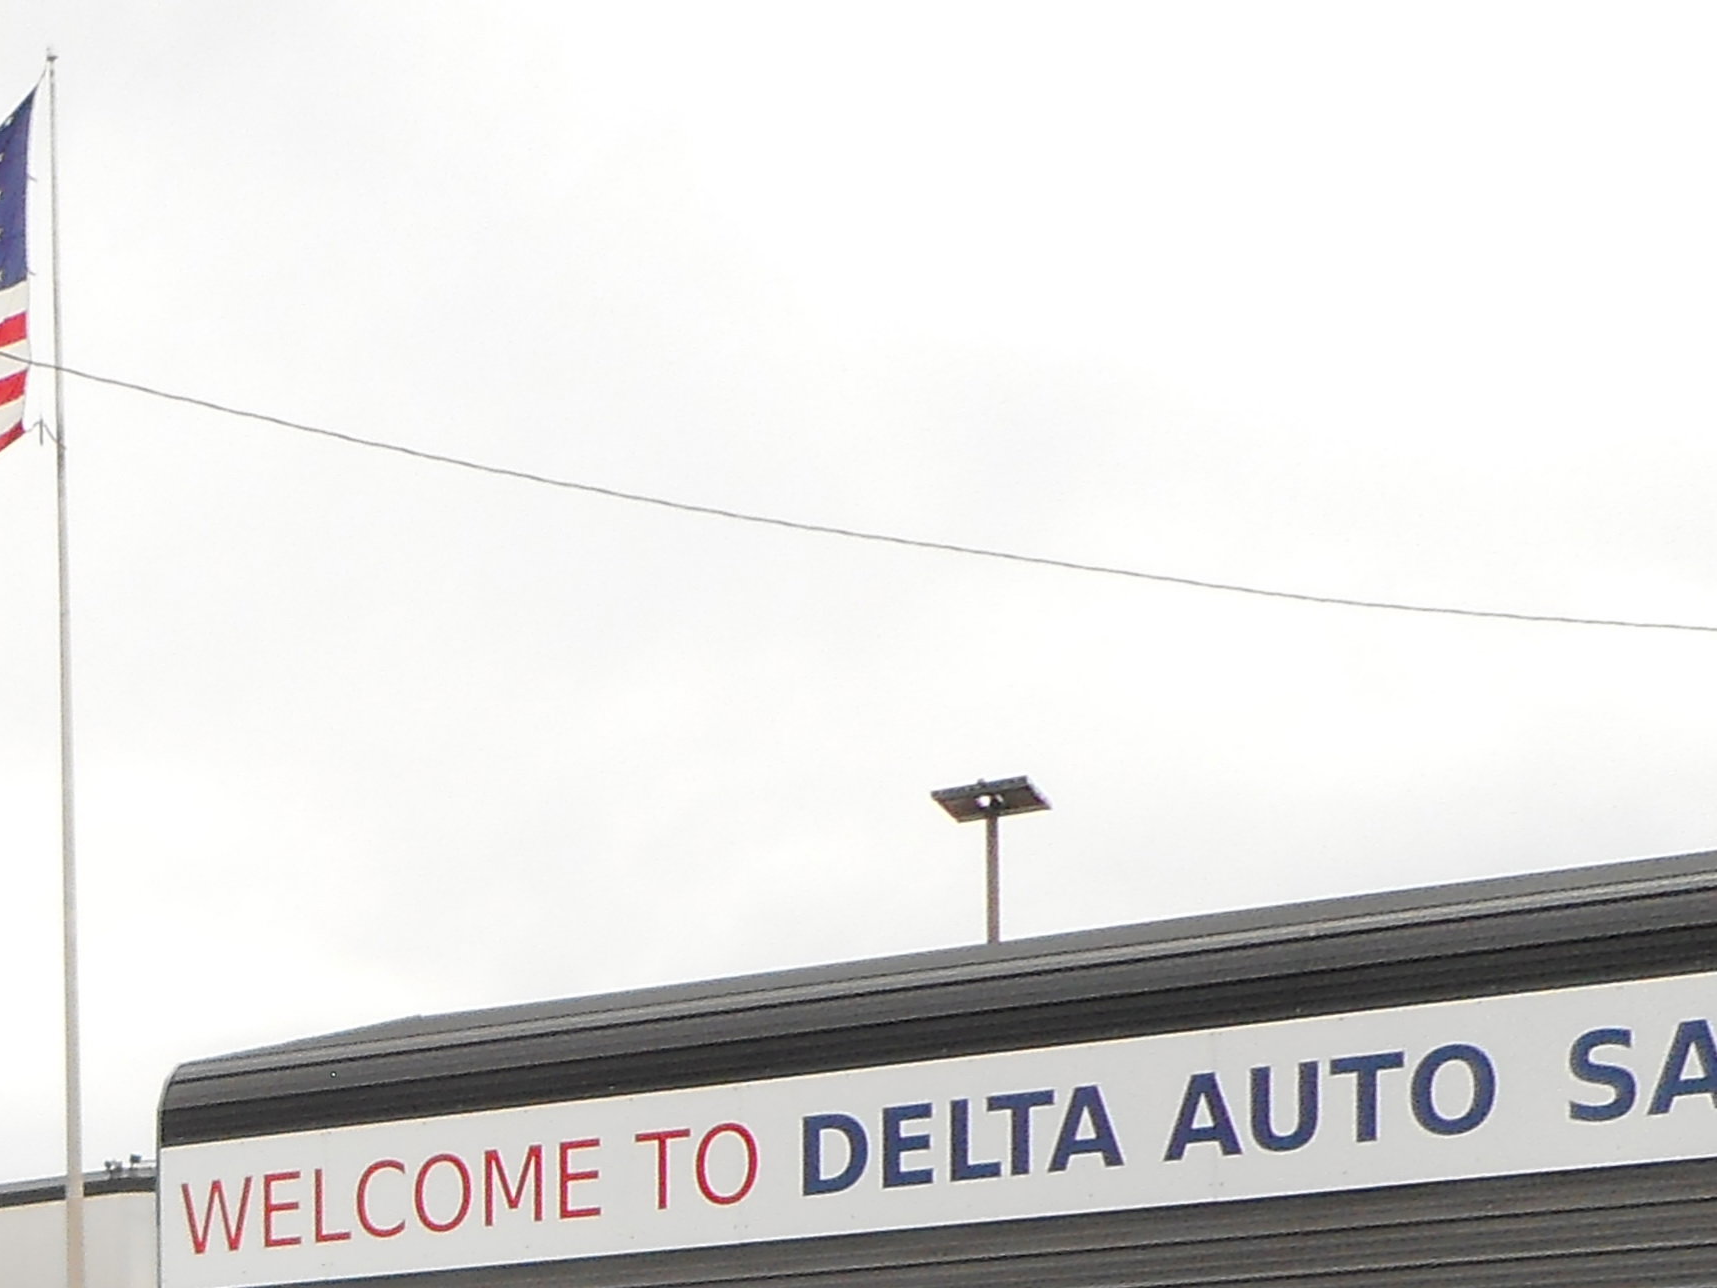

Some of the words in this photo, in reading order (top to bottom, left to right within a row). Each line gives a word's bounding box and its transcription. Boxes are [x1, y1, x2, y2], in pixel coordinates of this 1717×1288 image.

[180, 1138, 603, 1256] WELCOME
[635, 1121, 761, 1211] TO
[801, 1084, 1125, 1197] DELTA
[1163, 1042, 1498, 1162] AUTO
[1568, 1018, 1717, 1123] SA
